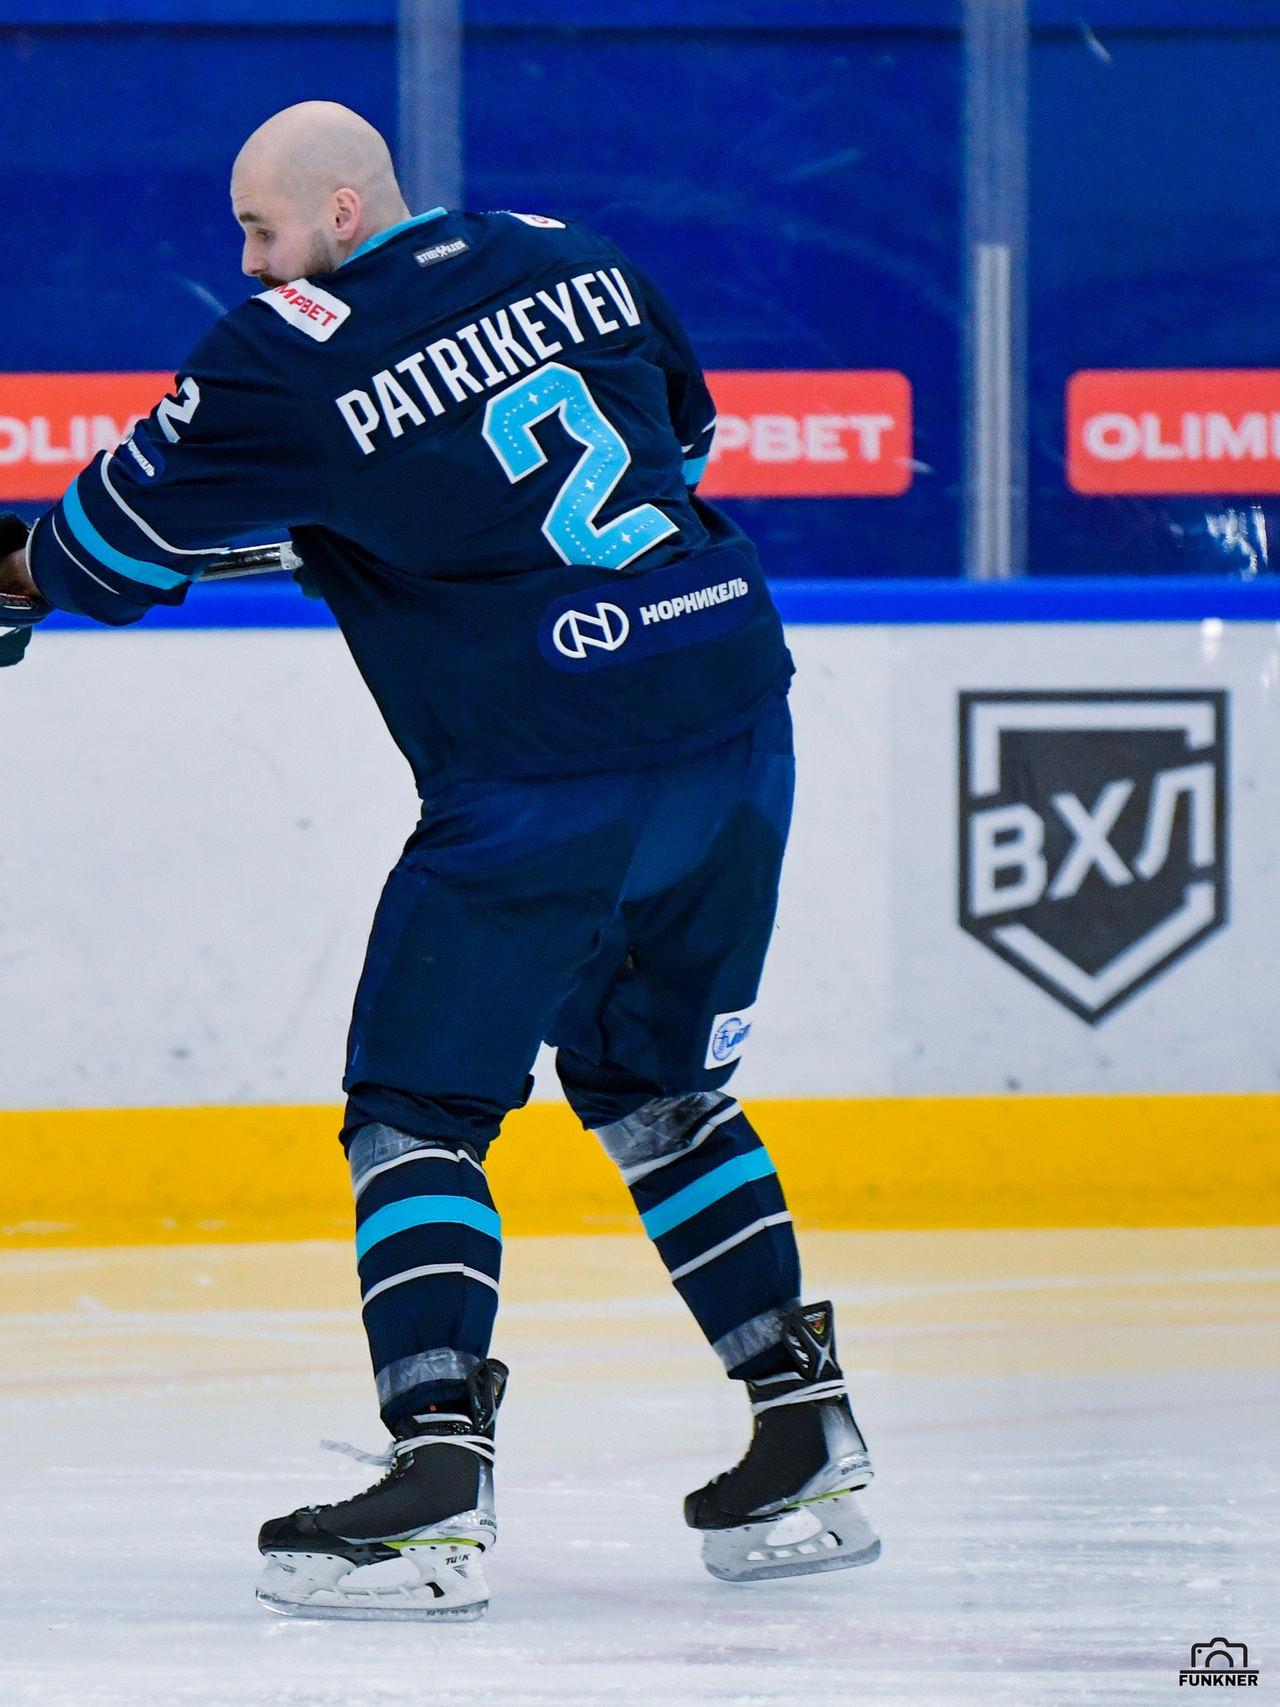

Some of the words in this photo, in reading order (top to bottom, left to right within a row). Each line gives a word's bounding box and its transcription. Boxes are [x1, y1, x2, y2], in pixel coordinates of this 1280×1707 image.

[335, 266, 642, 455] PATRIKEYEV
[1081, 411, 1280, 461] OLIM
[481, 361, 681, 570] 2
[639, 577, 749, 625] НОРНИКЕЛЬ
[970, 760, 1216, 919] ВХЛ
